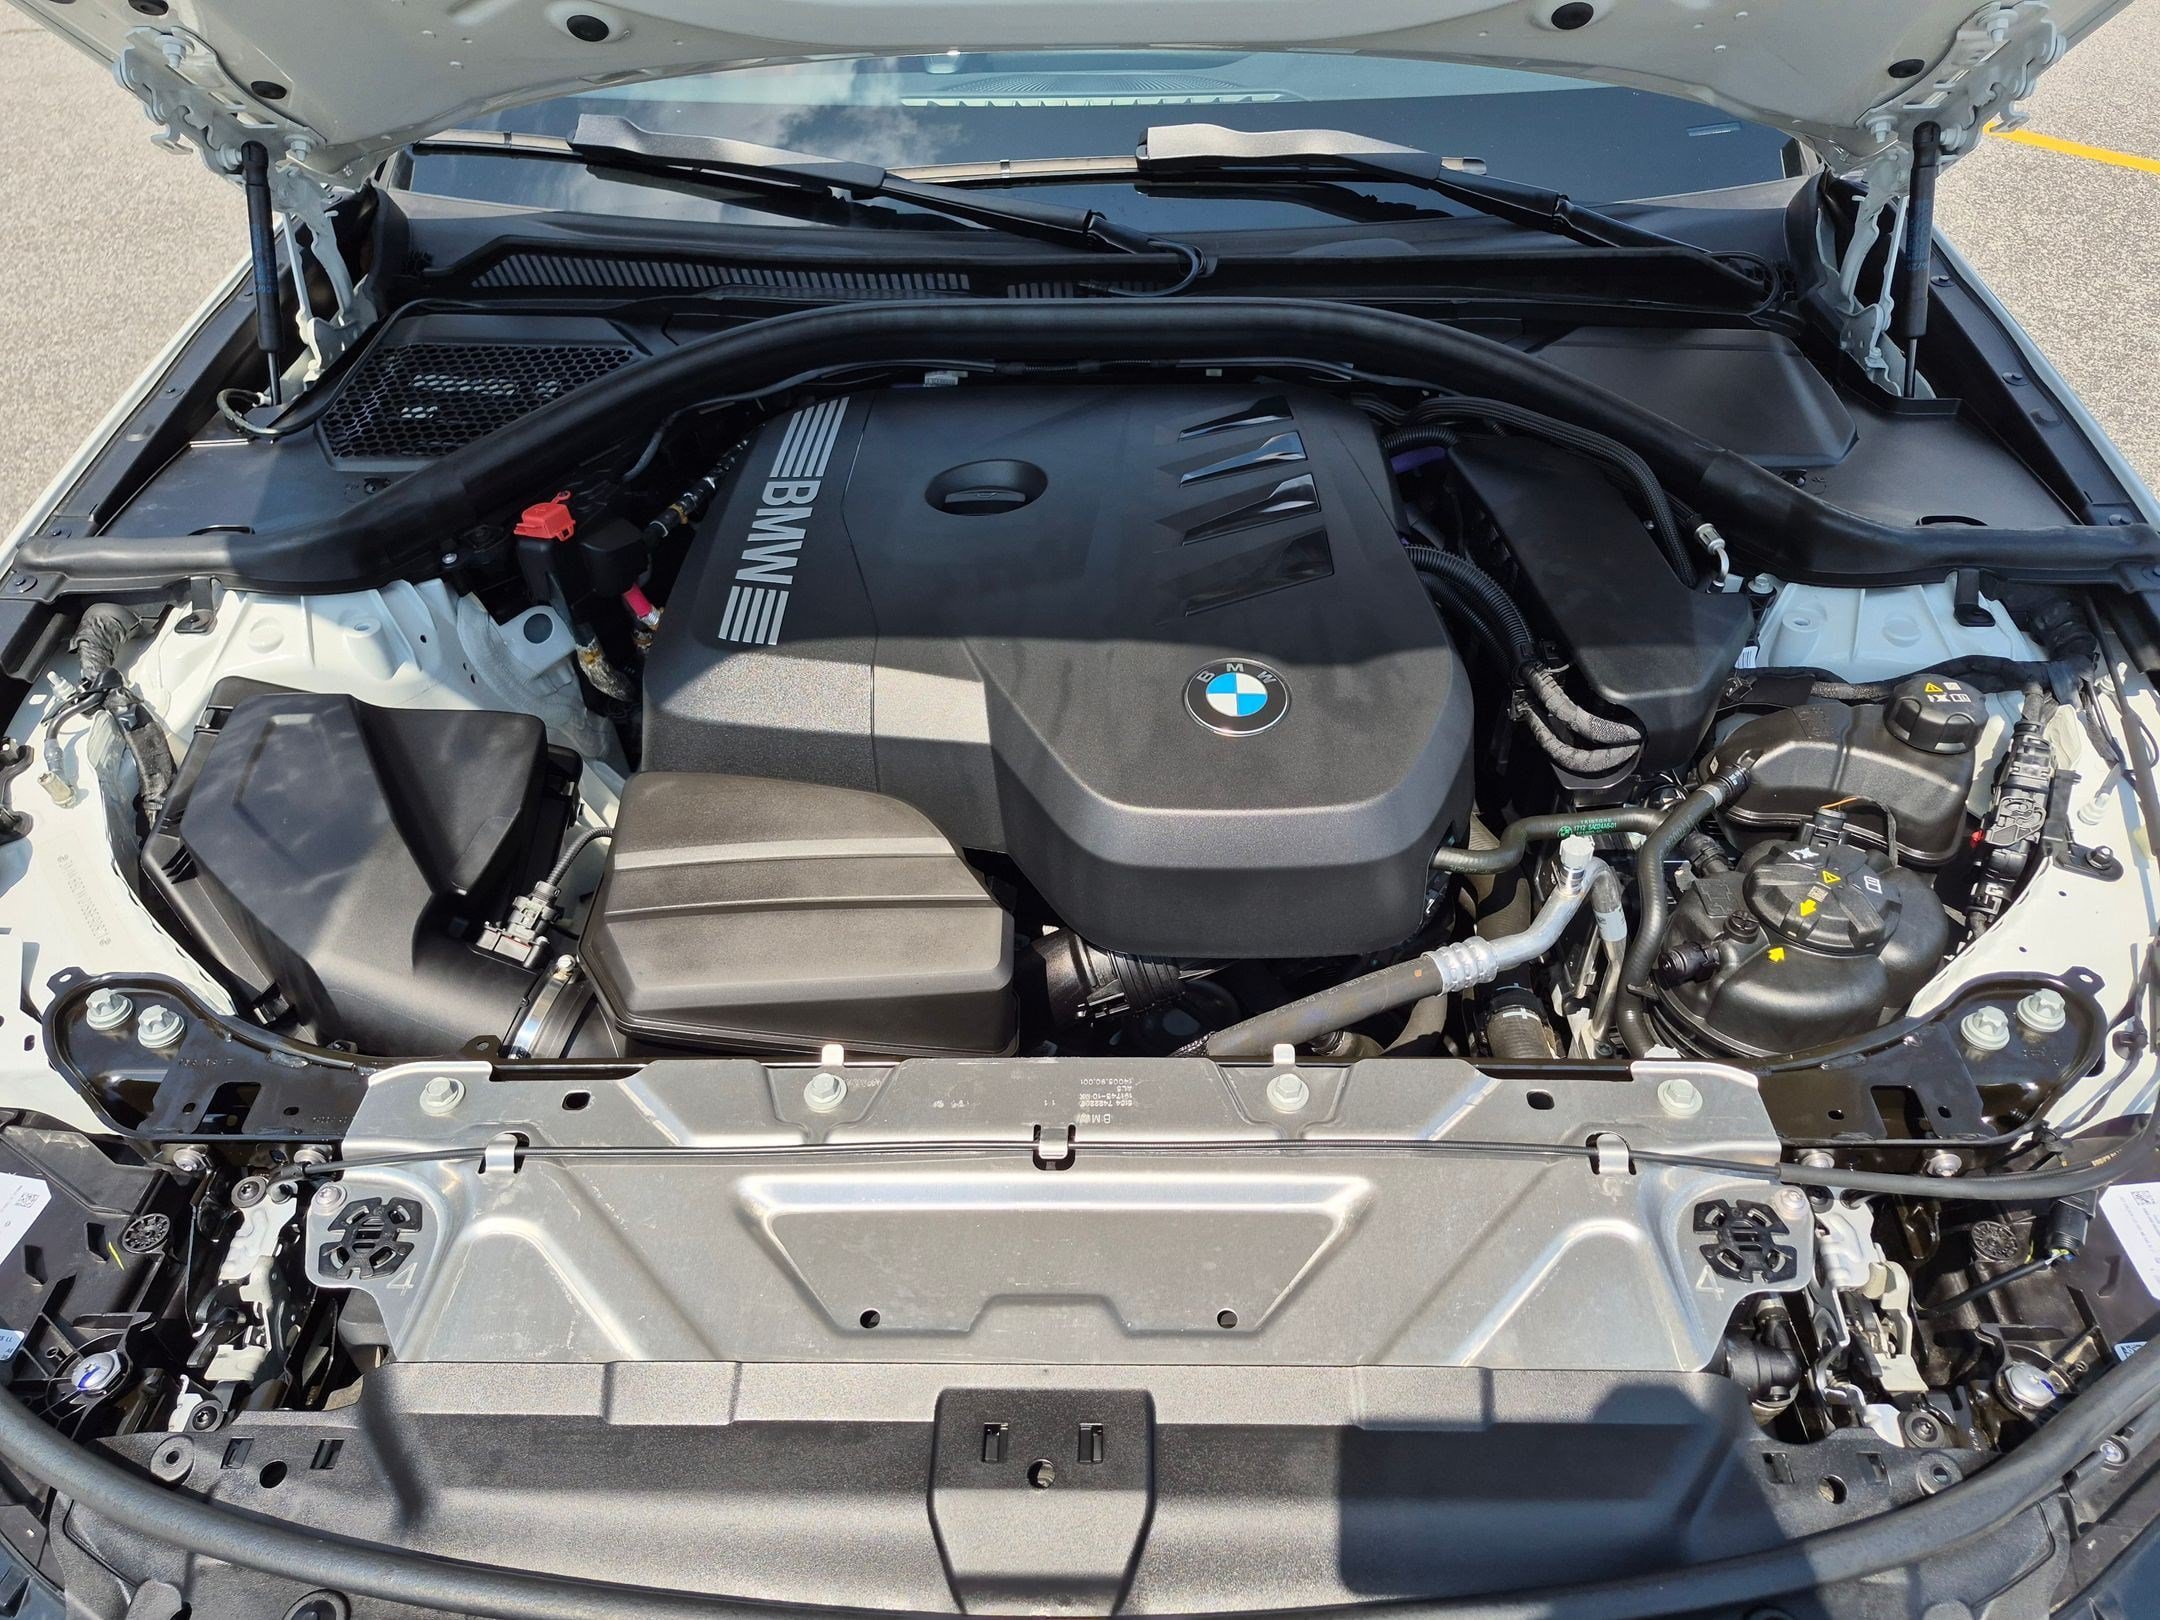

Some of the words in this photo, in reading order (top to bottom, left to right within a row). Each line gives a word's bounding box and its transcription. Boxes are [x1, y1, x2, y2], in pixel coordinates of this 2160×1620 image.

[735, 480, 821, 584] BMW
[1196, 663, 1277, 684] BMW
[386, 1262, 418, 1296] 4
[1695, 1264, 1725, 1301] 4
